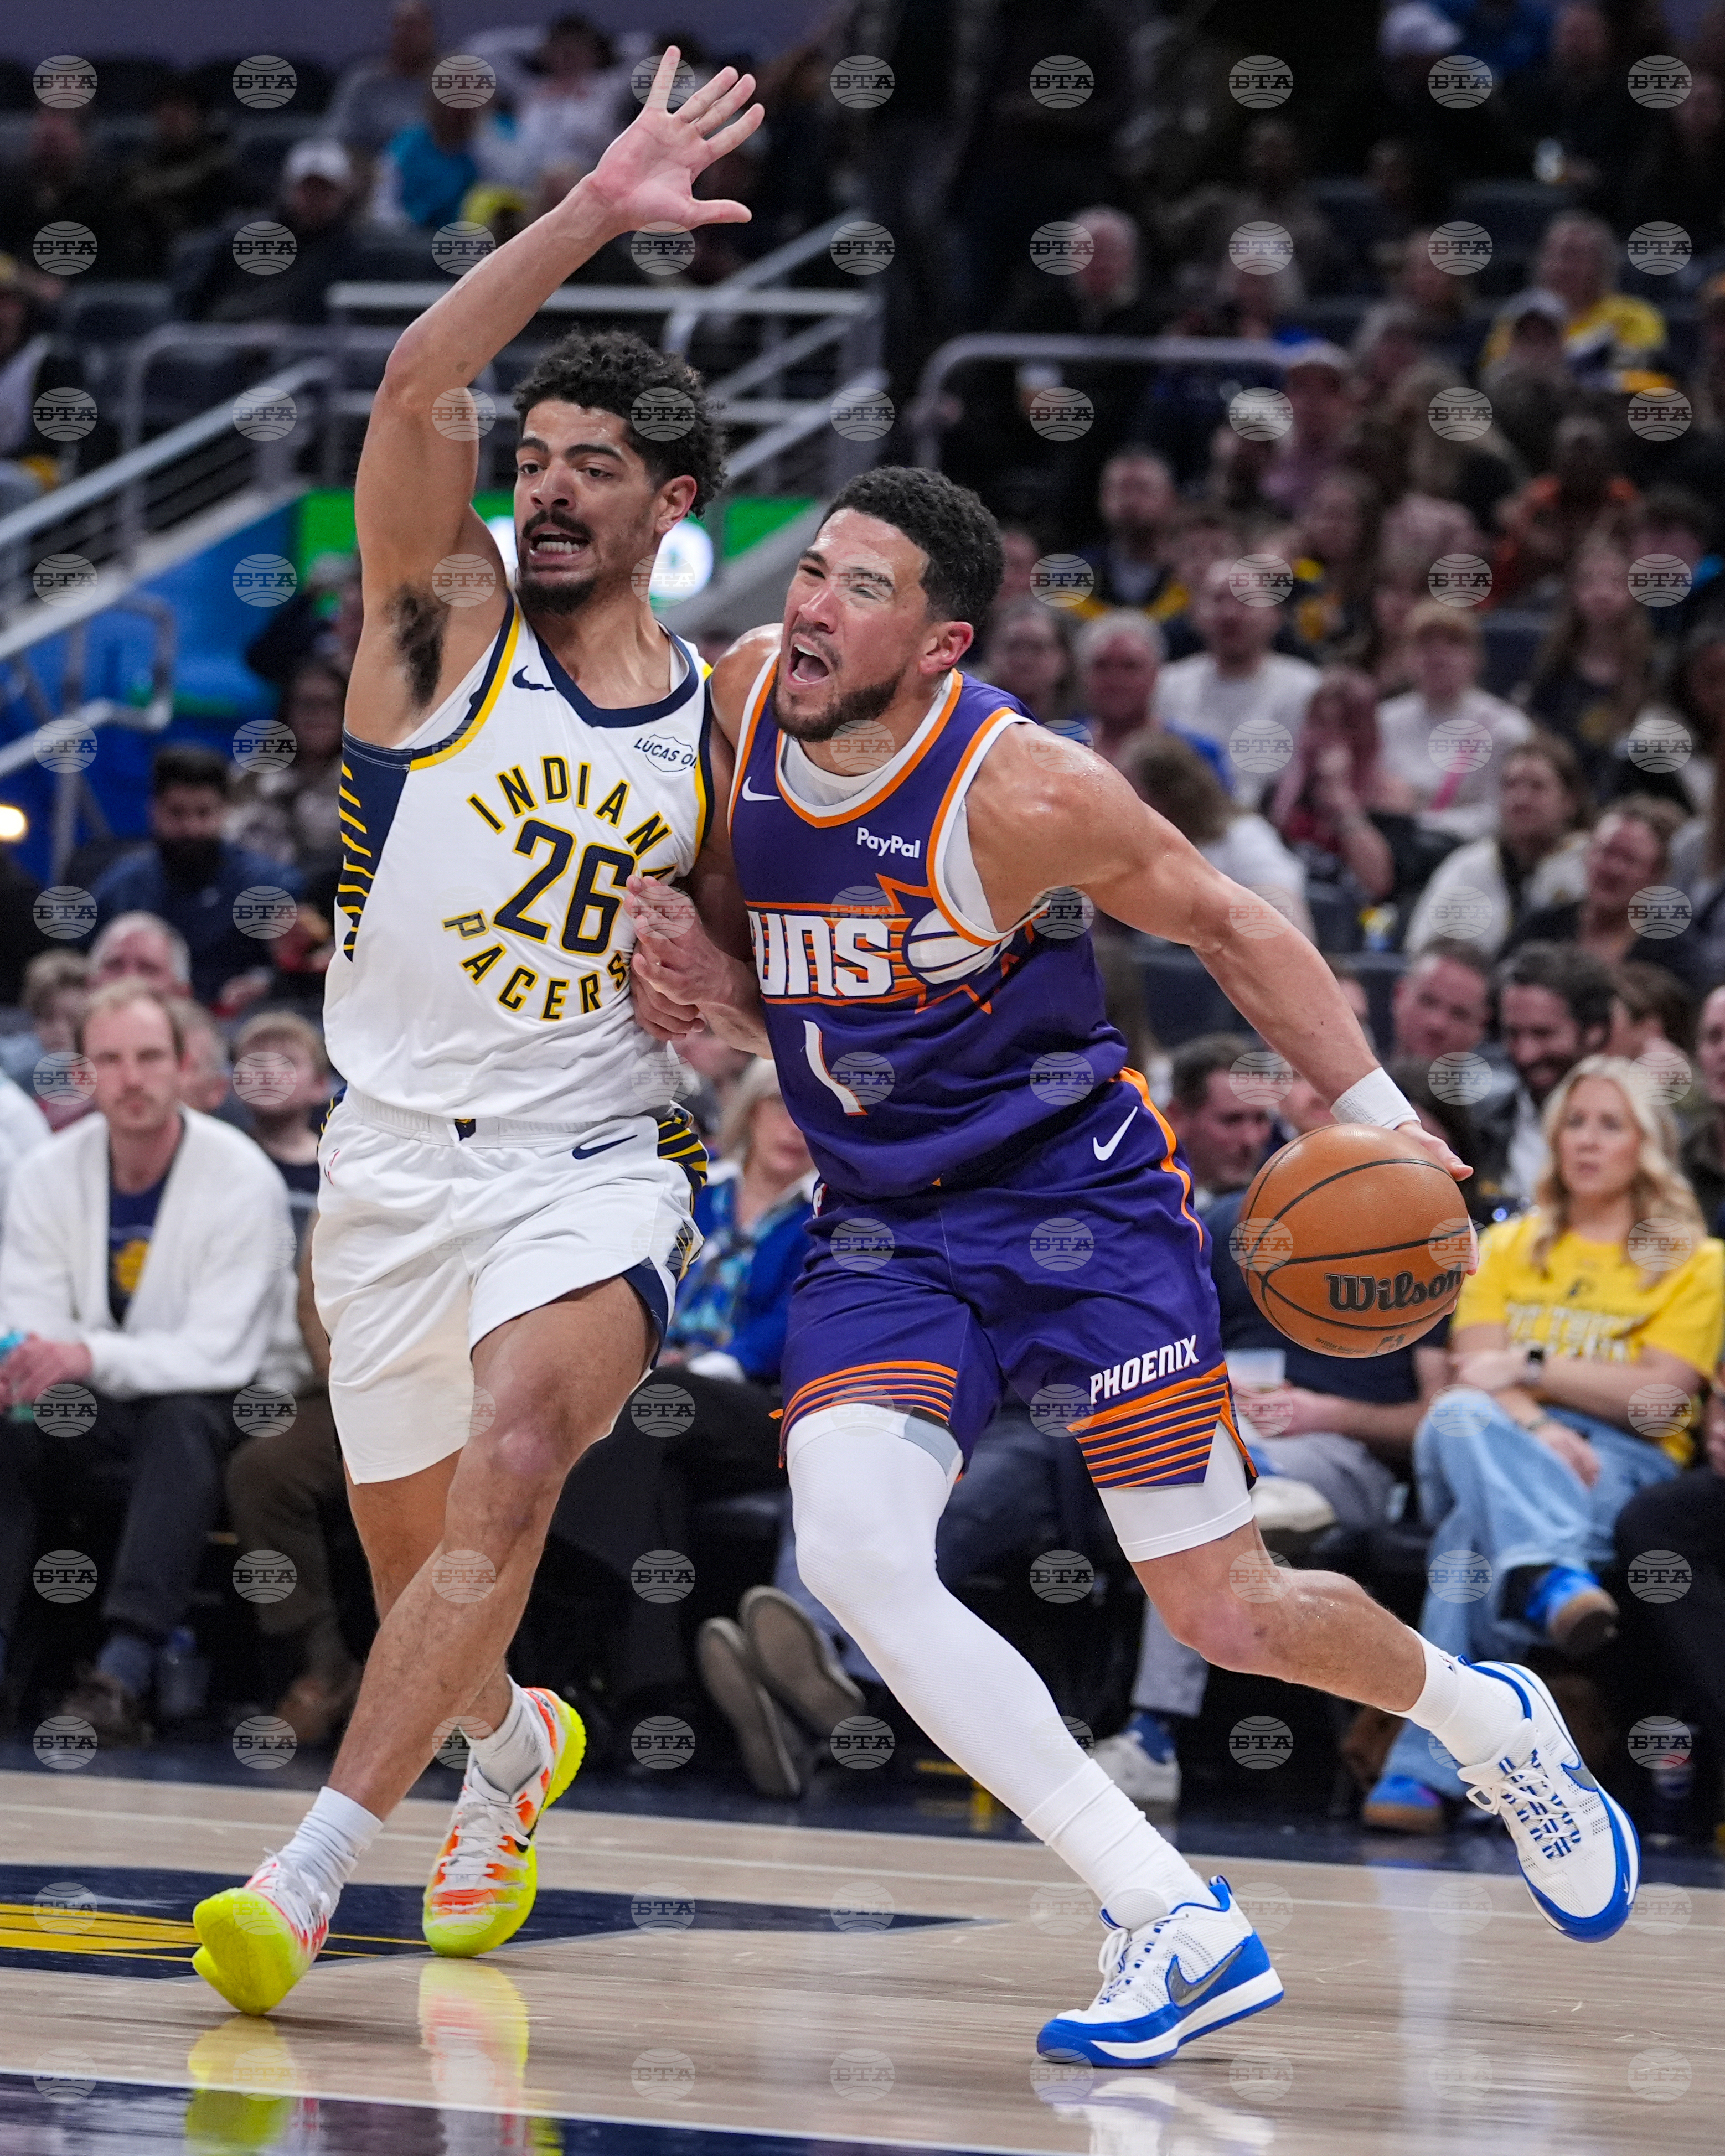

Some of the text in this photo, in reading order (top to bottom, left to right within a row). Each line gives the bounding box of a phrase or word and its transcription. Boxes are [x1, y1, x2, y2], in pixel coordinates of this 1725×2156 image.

[634, 738, 680, 761] LUCAS
[681, 753, 697, 768] OI
[856, 826, 921, 859] PayPal
[493, 818, 638, 956] 26
[443, 909, 630, 1021] PACERS
[747, 910, 892, 996] UNS
[1325, 1261, 1462, 1312] Wilson
[1090, 1334, 1200, 1405] PHOENIX
